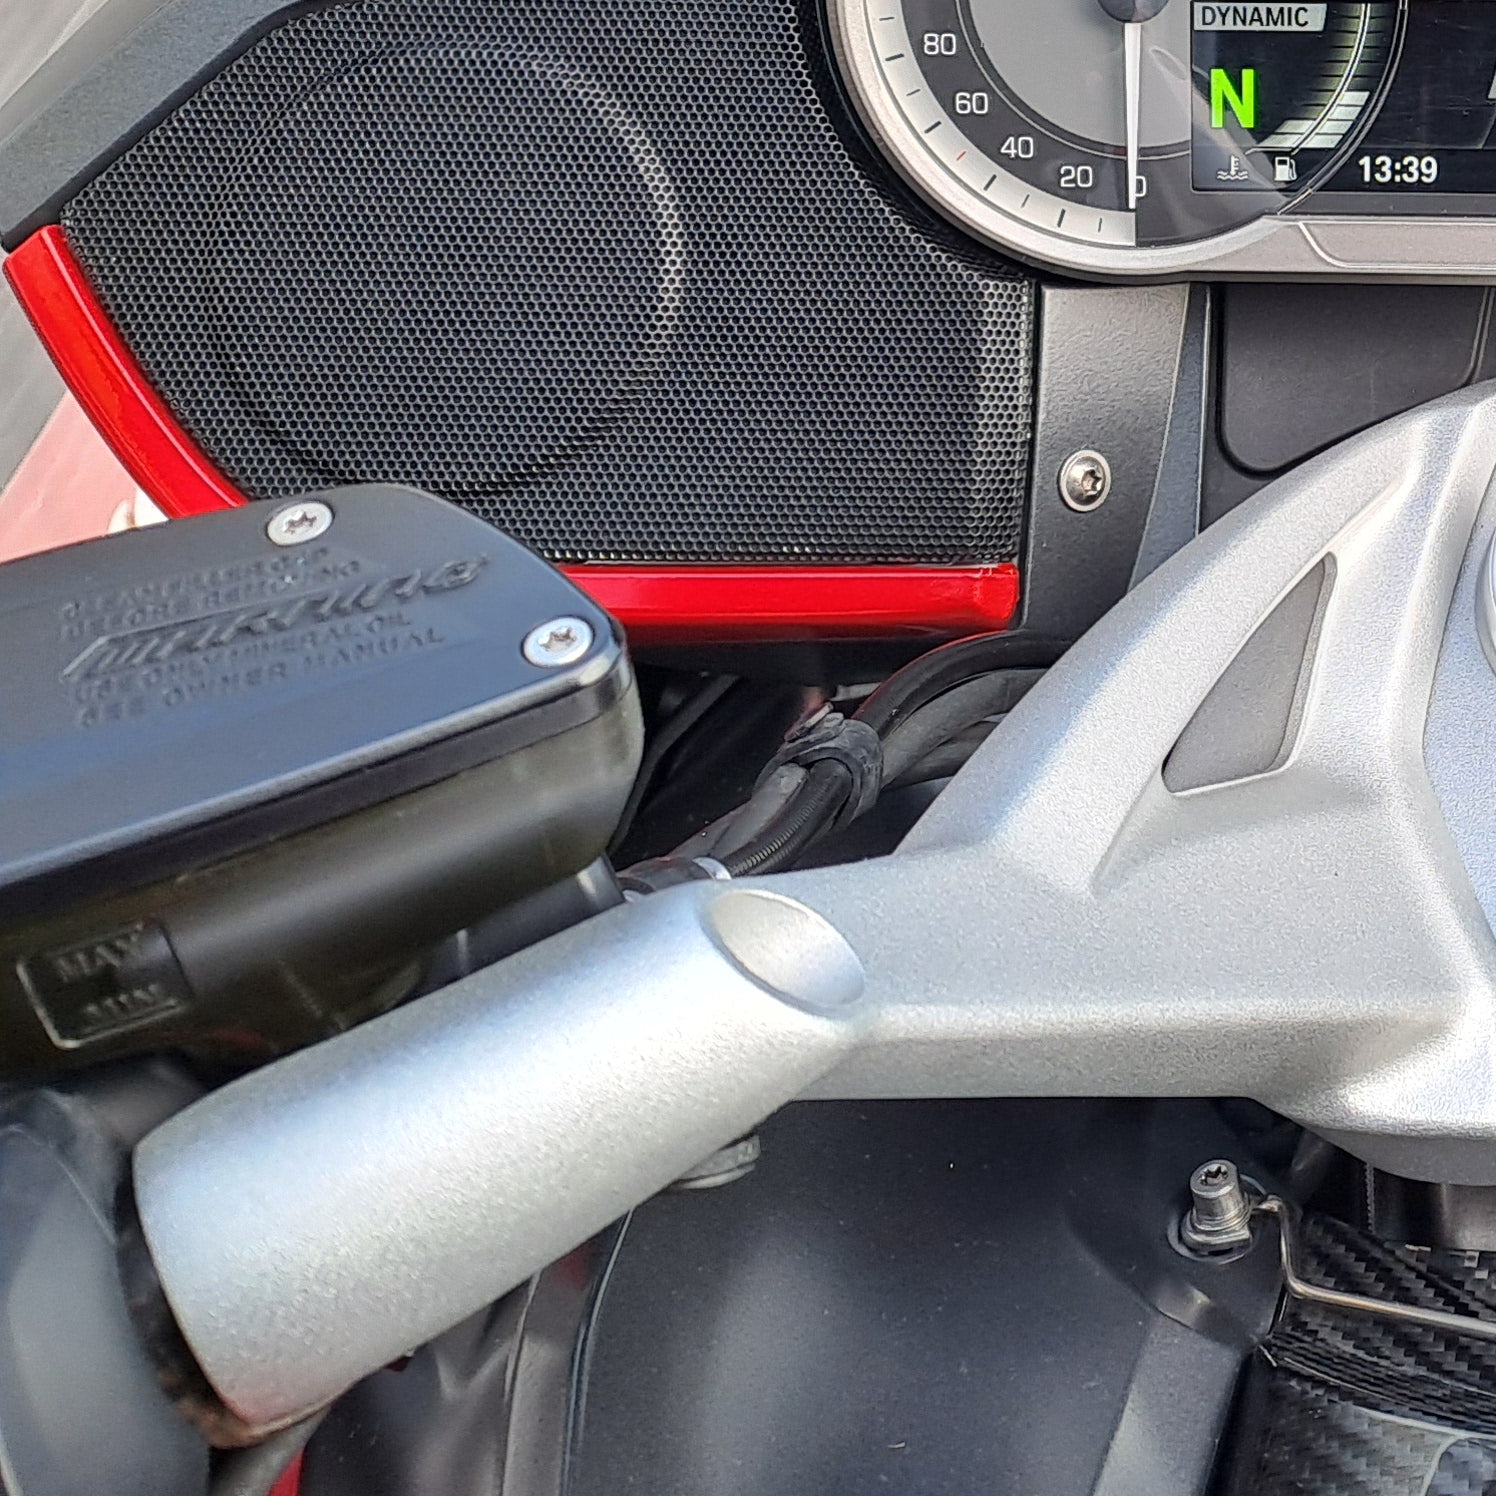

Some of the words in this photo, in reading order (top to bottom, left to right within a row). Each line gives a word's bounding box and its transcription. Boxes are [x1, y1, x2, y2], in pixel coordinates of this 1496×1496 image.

[1201, 7, 1309, 27] DYNAMIC
[924, 34, 956, 55] 80
[955, 93, 988, 115] 60
[1210, 69, 1254, 128] N
[1001, 136, 1034, 158] 40
[1060, 166, 1093, 187] 20
[1358, 156, 1438, 182] 13:39
